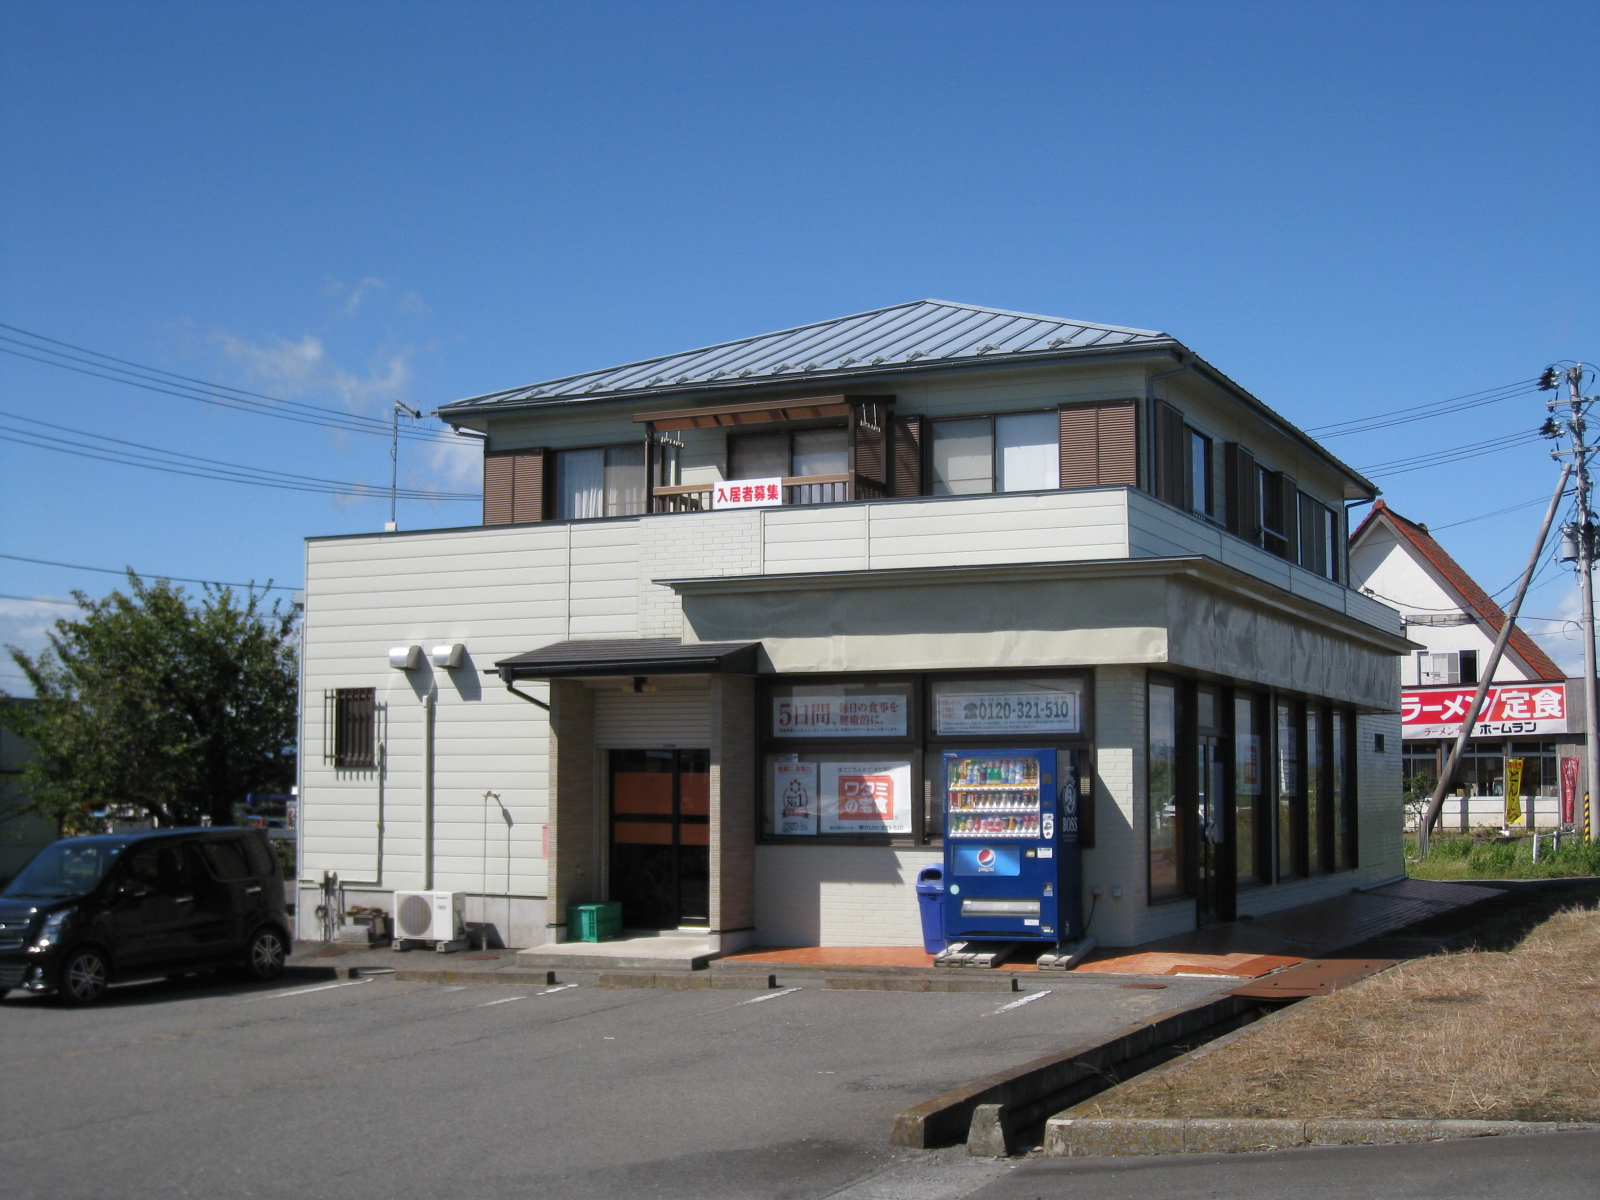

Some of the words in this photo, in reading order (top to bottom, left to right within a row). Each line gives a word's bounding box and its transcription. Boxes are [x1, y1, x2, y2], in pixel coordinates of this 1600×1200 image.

[717, 484, 779, 503] 入居者募集
[839, 701, 899, 714] 毎日の食事を
[979, 700, 1069, 720] 0120-321-510
[1402, 694, 1491, 722] ラーメン
[1501, 688, 1563, 719] 定食
[1424, 725, 1475, 736] ラーメン
[1480, 721, 1537, 735] ホームラン
[844, 781, 889, 796] ワタミ
[1508, 770, 1520, 822] とんつ
[844, 796, 888, 814] の宅食
[1062, 817, 1078, 832] BOSS
